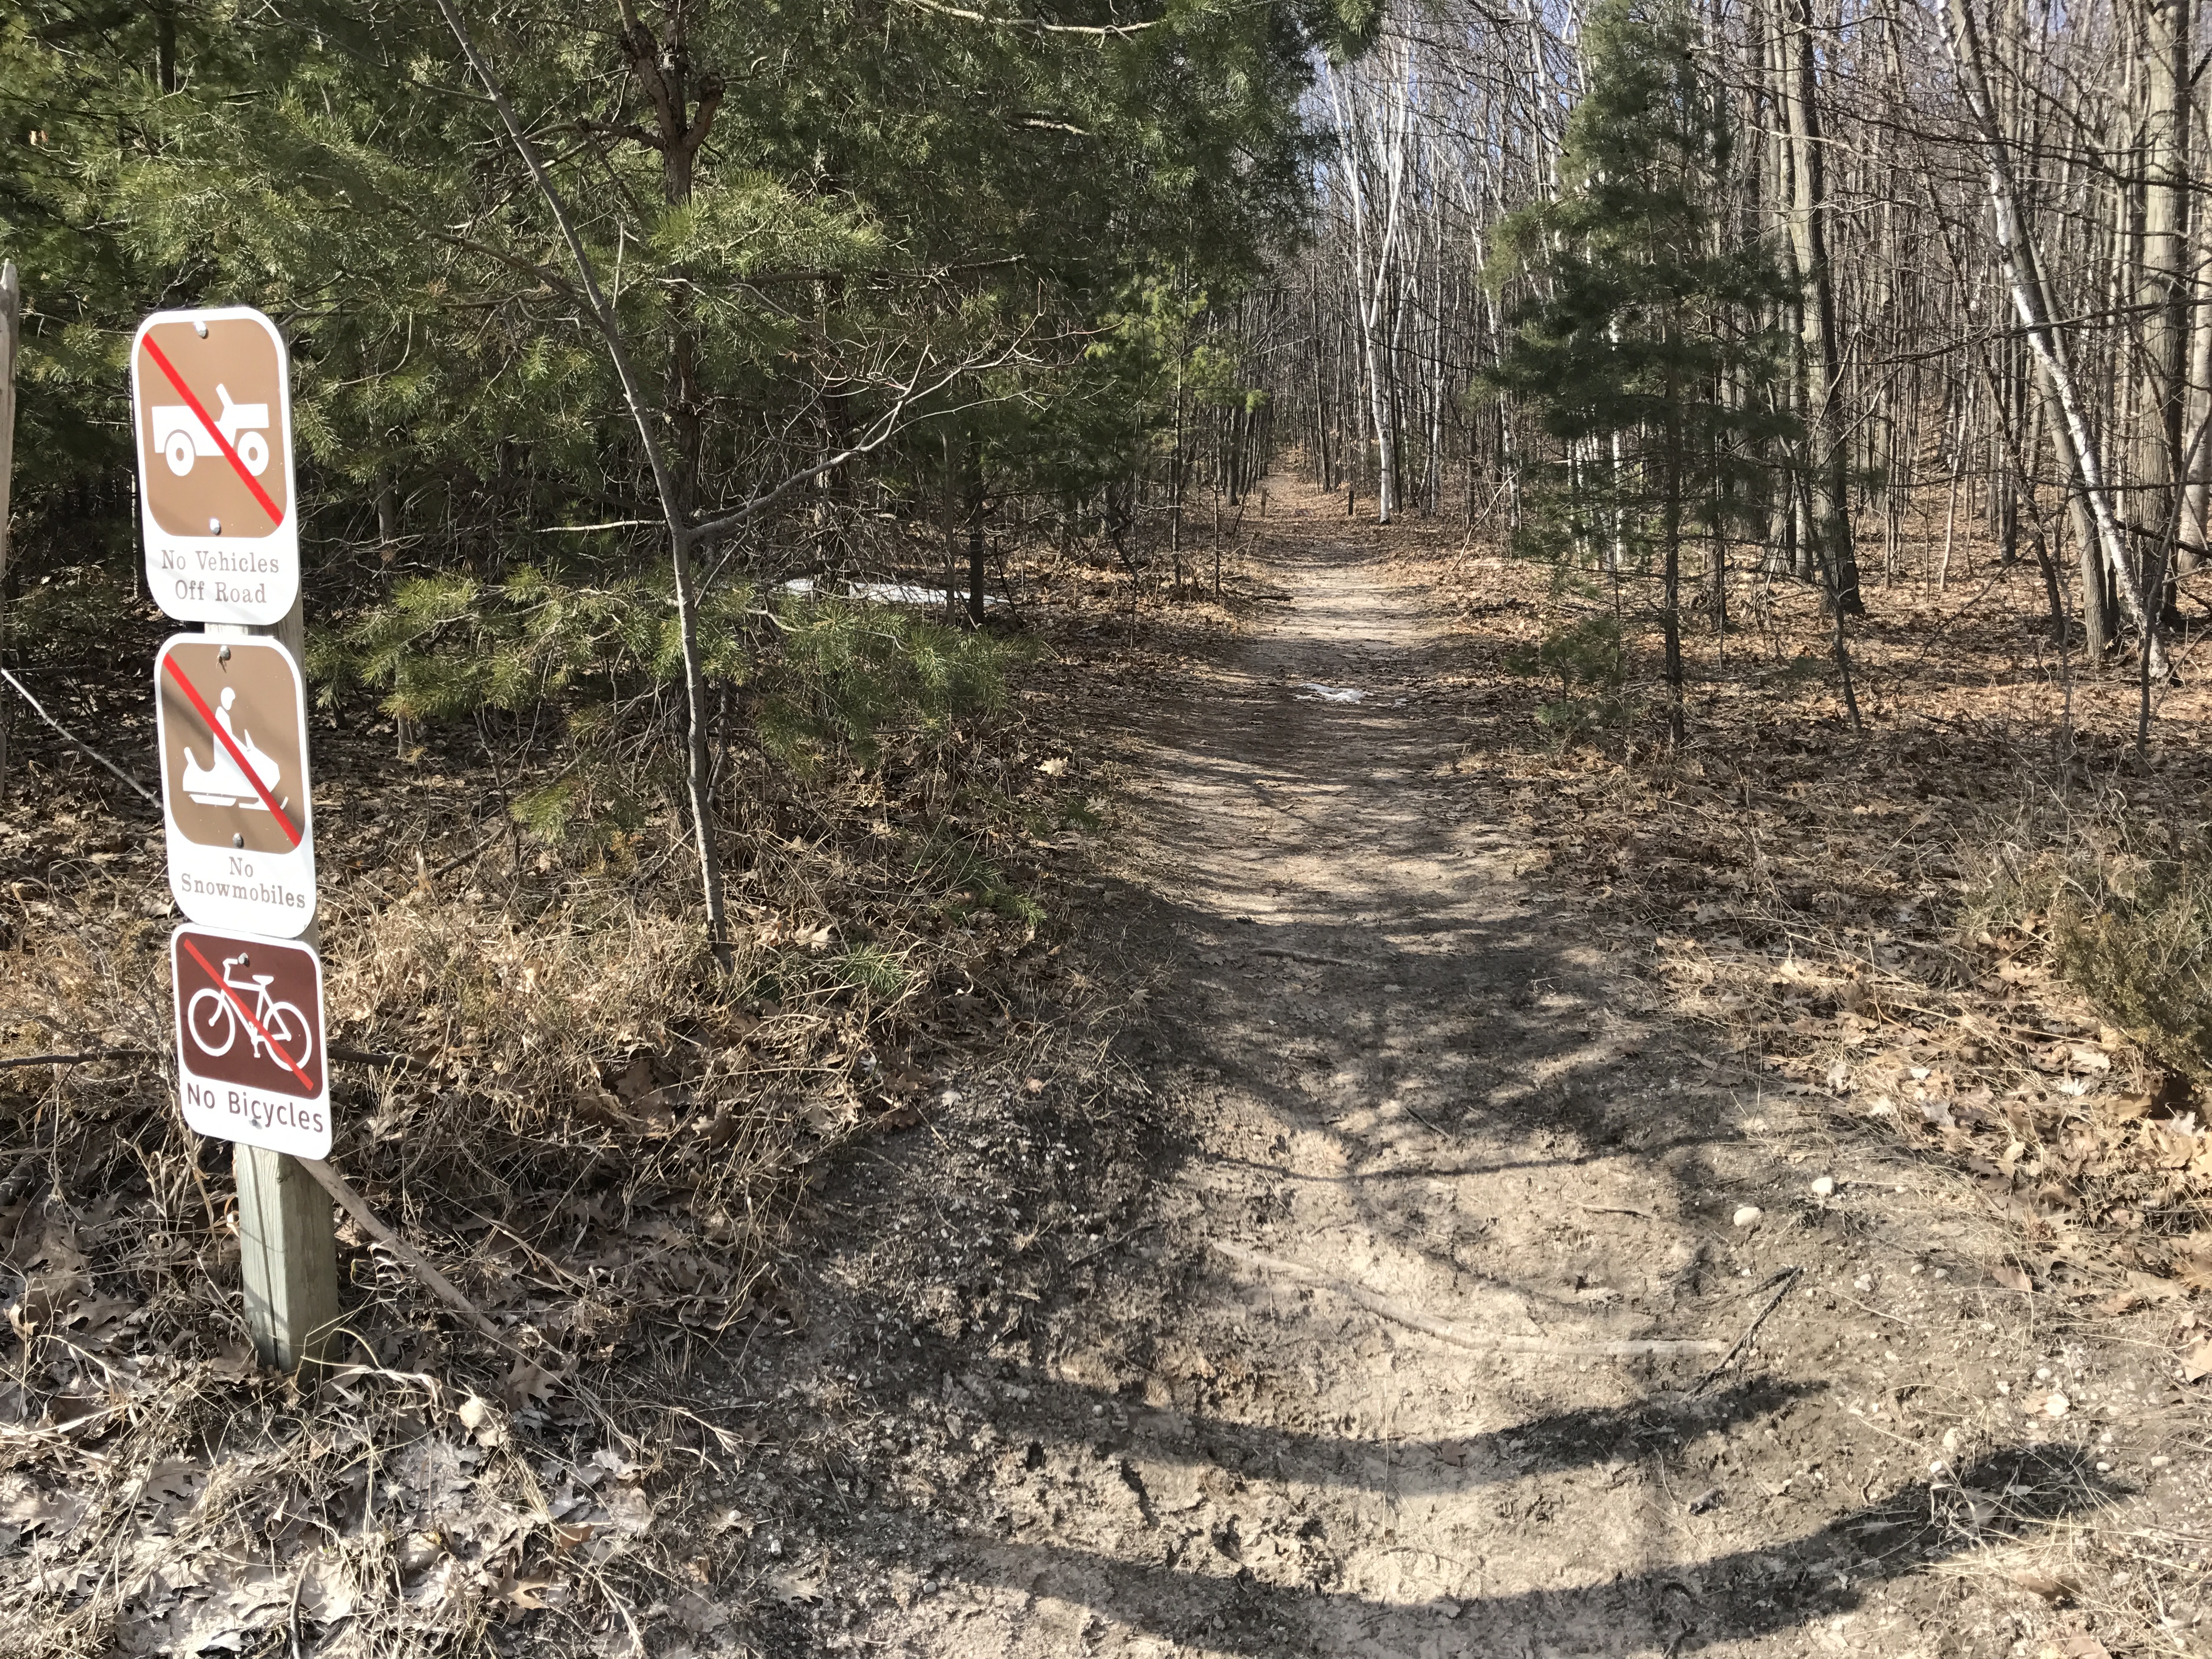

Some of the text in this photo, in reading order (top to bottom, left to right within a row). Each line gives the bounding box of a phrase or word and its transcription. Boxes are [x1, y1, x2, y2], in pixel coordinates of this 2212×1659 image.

[161, 549, 279, 573] No Vehicles
[175, 579, 267, 603] Off Road
[228, 856, 253, 878] No
[181, 873, 306, 909] Snowmobiles
[187, 1082, 323, 1133] No Bicycles
